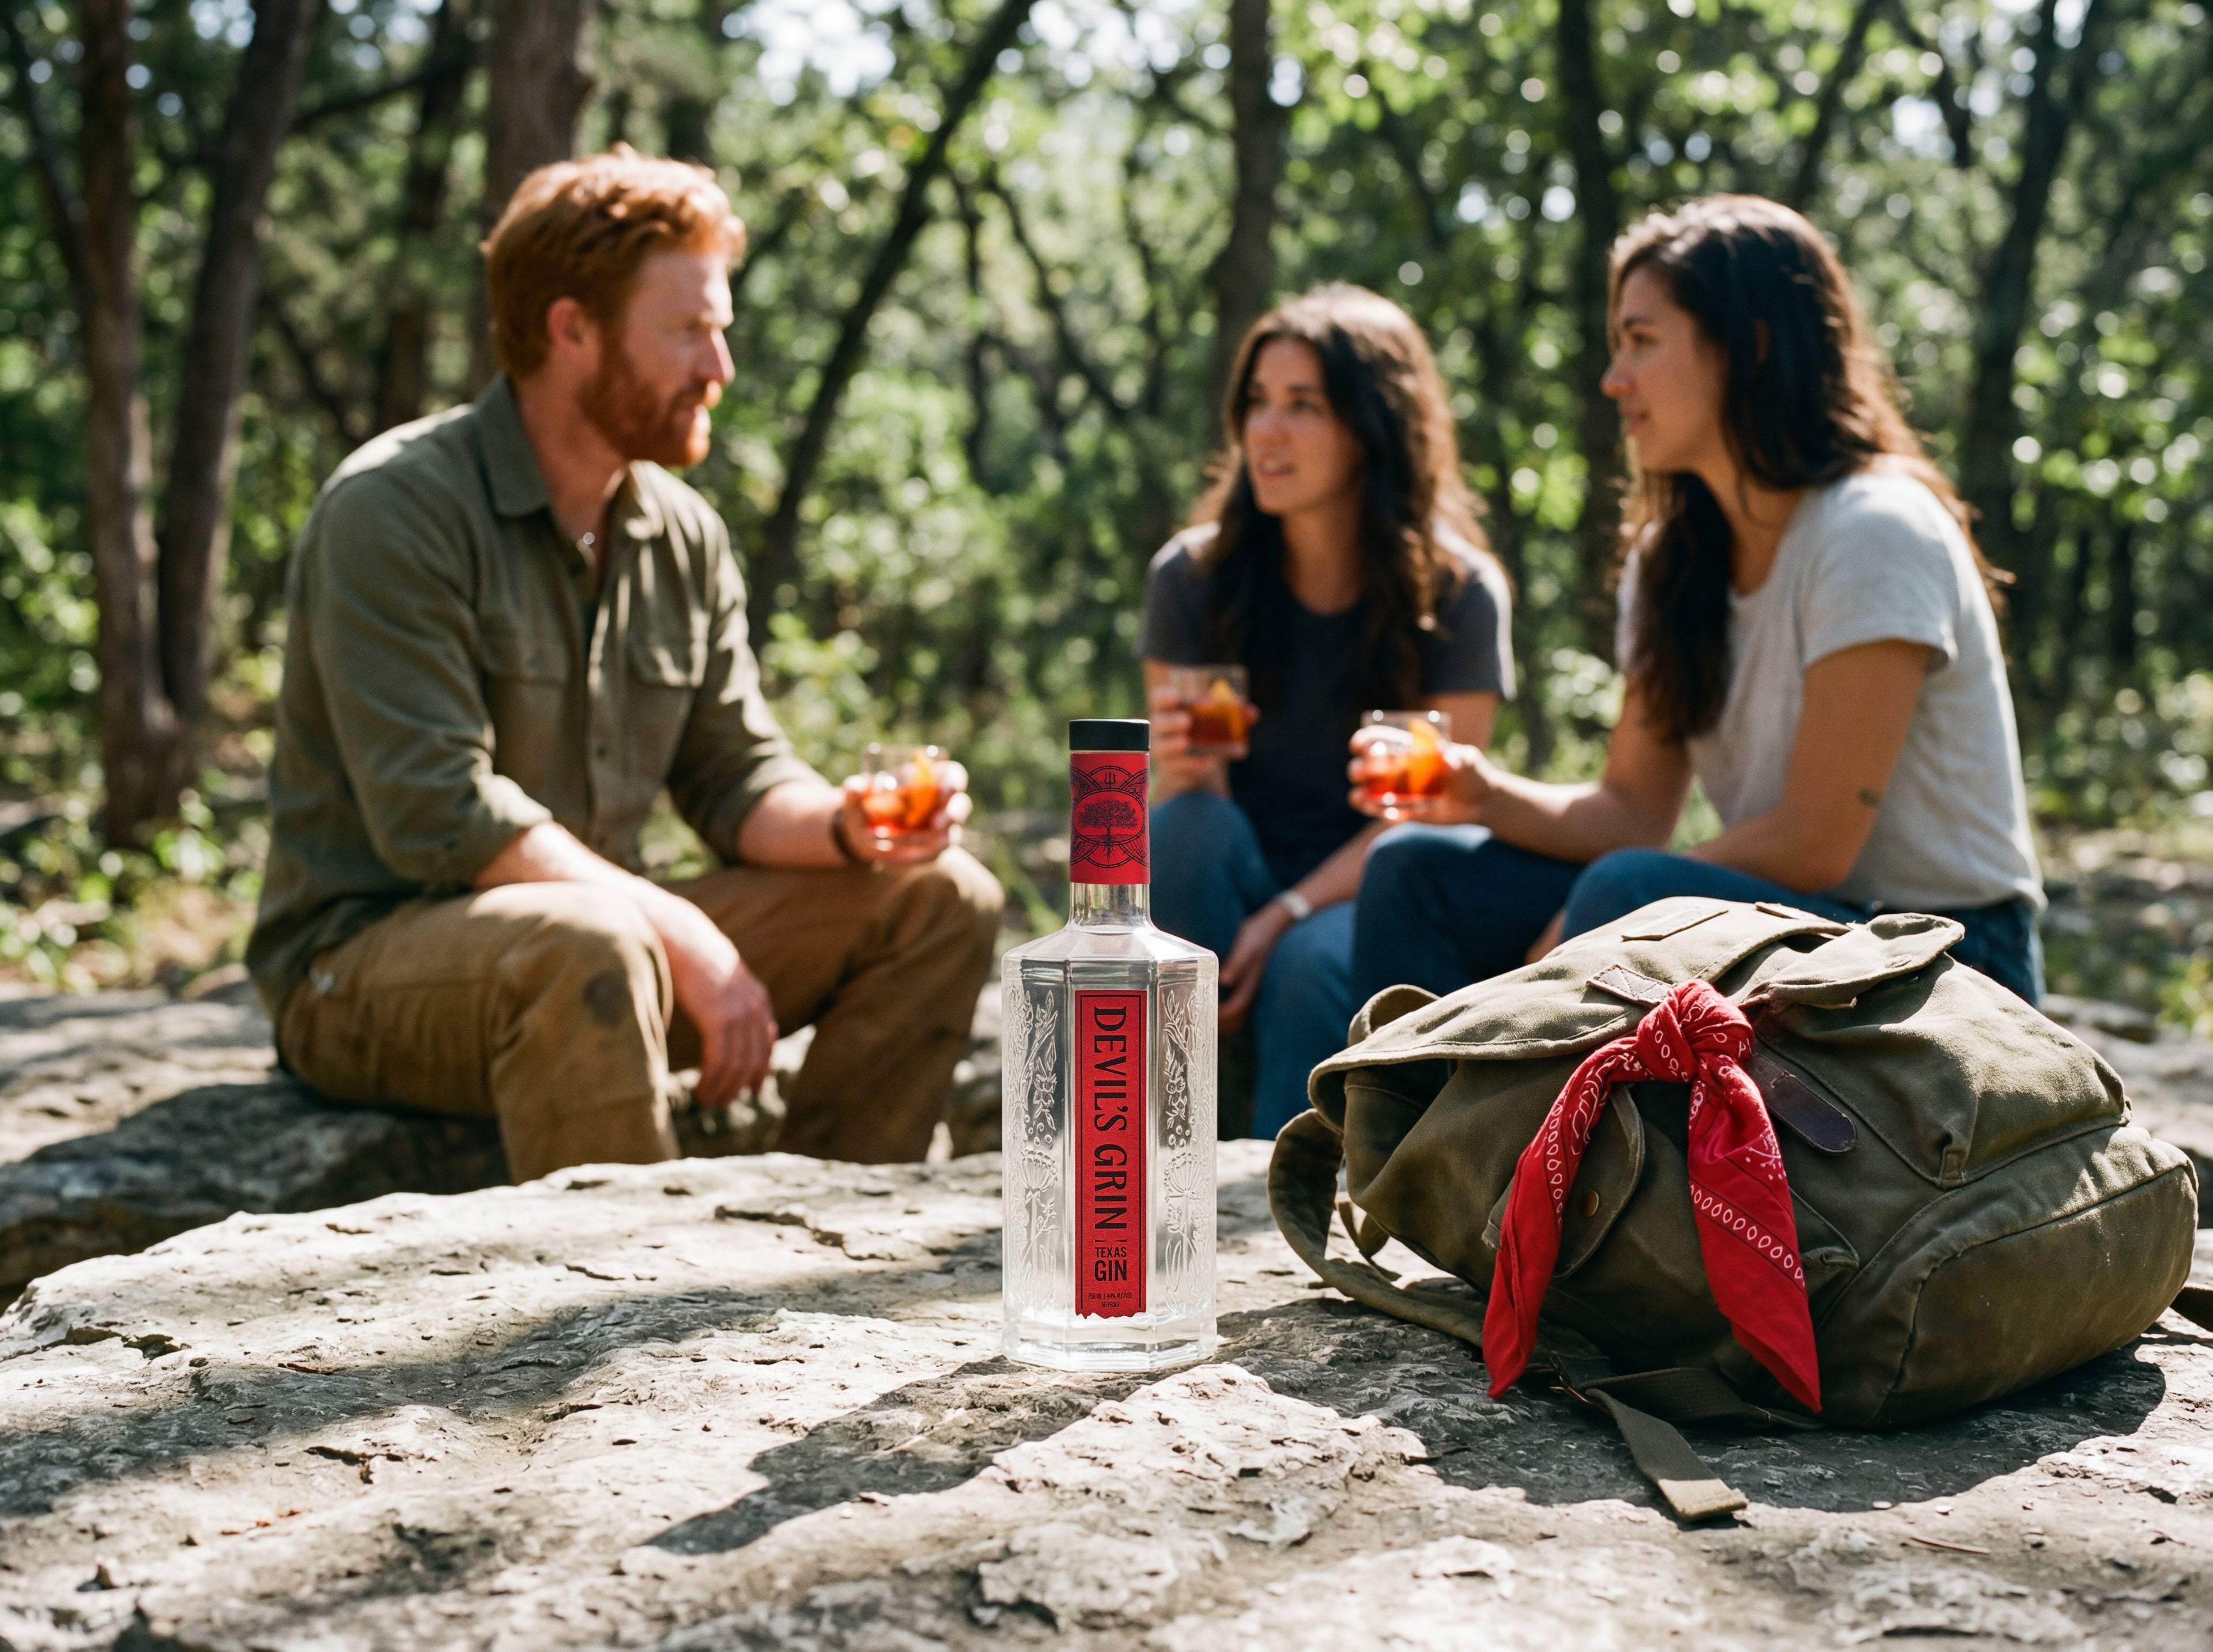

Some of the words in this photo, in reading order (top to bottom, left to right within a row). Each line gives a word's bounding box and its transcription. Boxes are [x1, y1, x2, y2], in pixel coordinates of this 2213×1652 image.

[1093, 1005, 1128, 1132] DEVIL'S
[1093, 1144, 1127, 1229] GRIN
[1095, 1247, 1127, 1258] TEXAS
[1095, 1260, 1127, 1281] GIN
